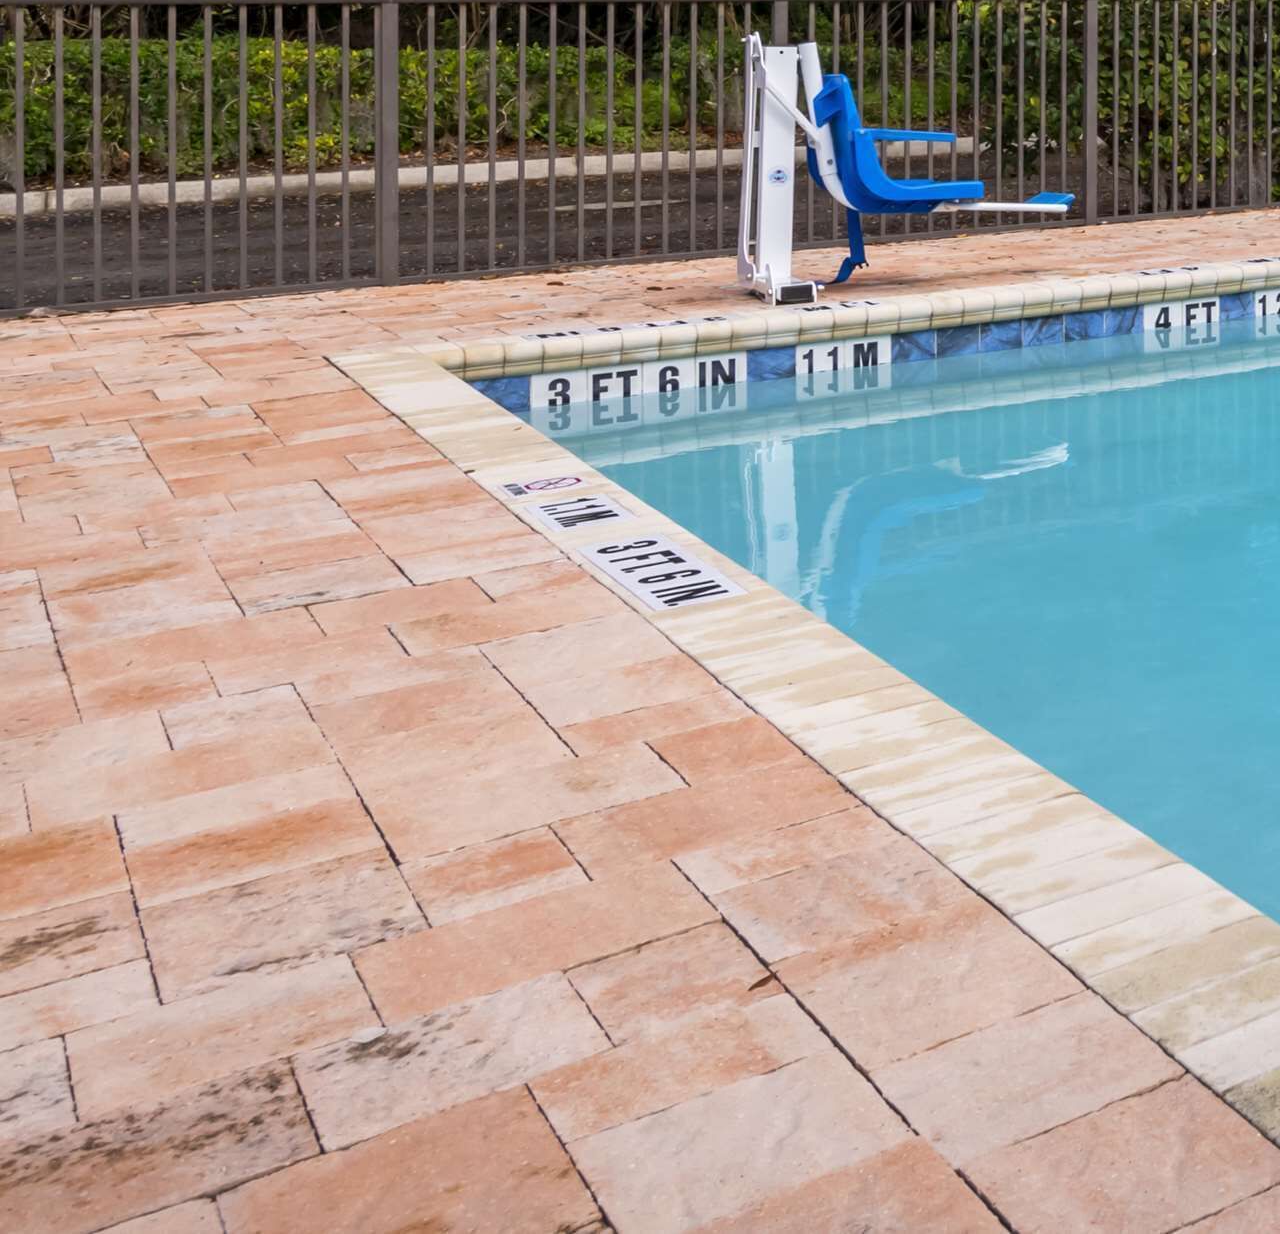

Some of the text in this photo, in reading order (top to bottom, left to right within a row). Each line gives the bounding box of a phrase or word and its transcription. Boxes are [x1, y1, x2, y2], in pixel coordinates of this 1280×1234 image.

[1155, 301, 1216, 329] 4 FT
[548, 358, 736, 407] 3 FT 6 IN
[539, 498, 619, 528] 1.1 M.
[596, 540, 729, 607] 3 FT. 6 IN.
